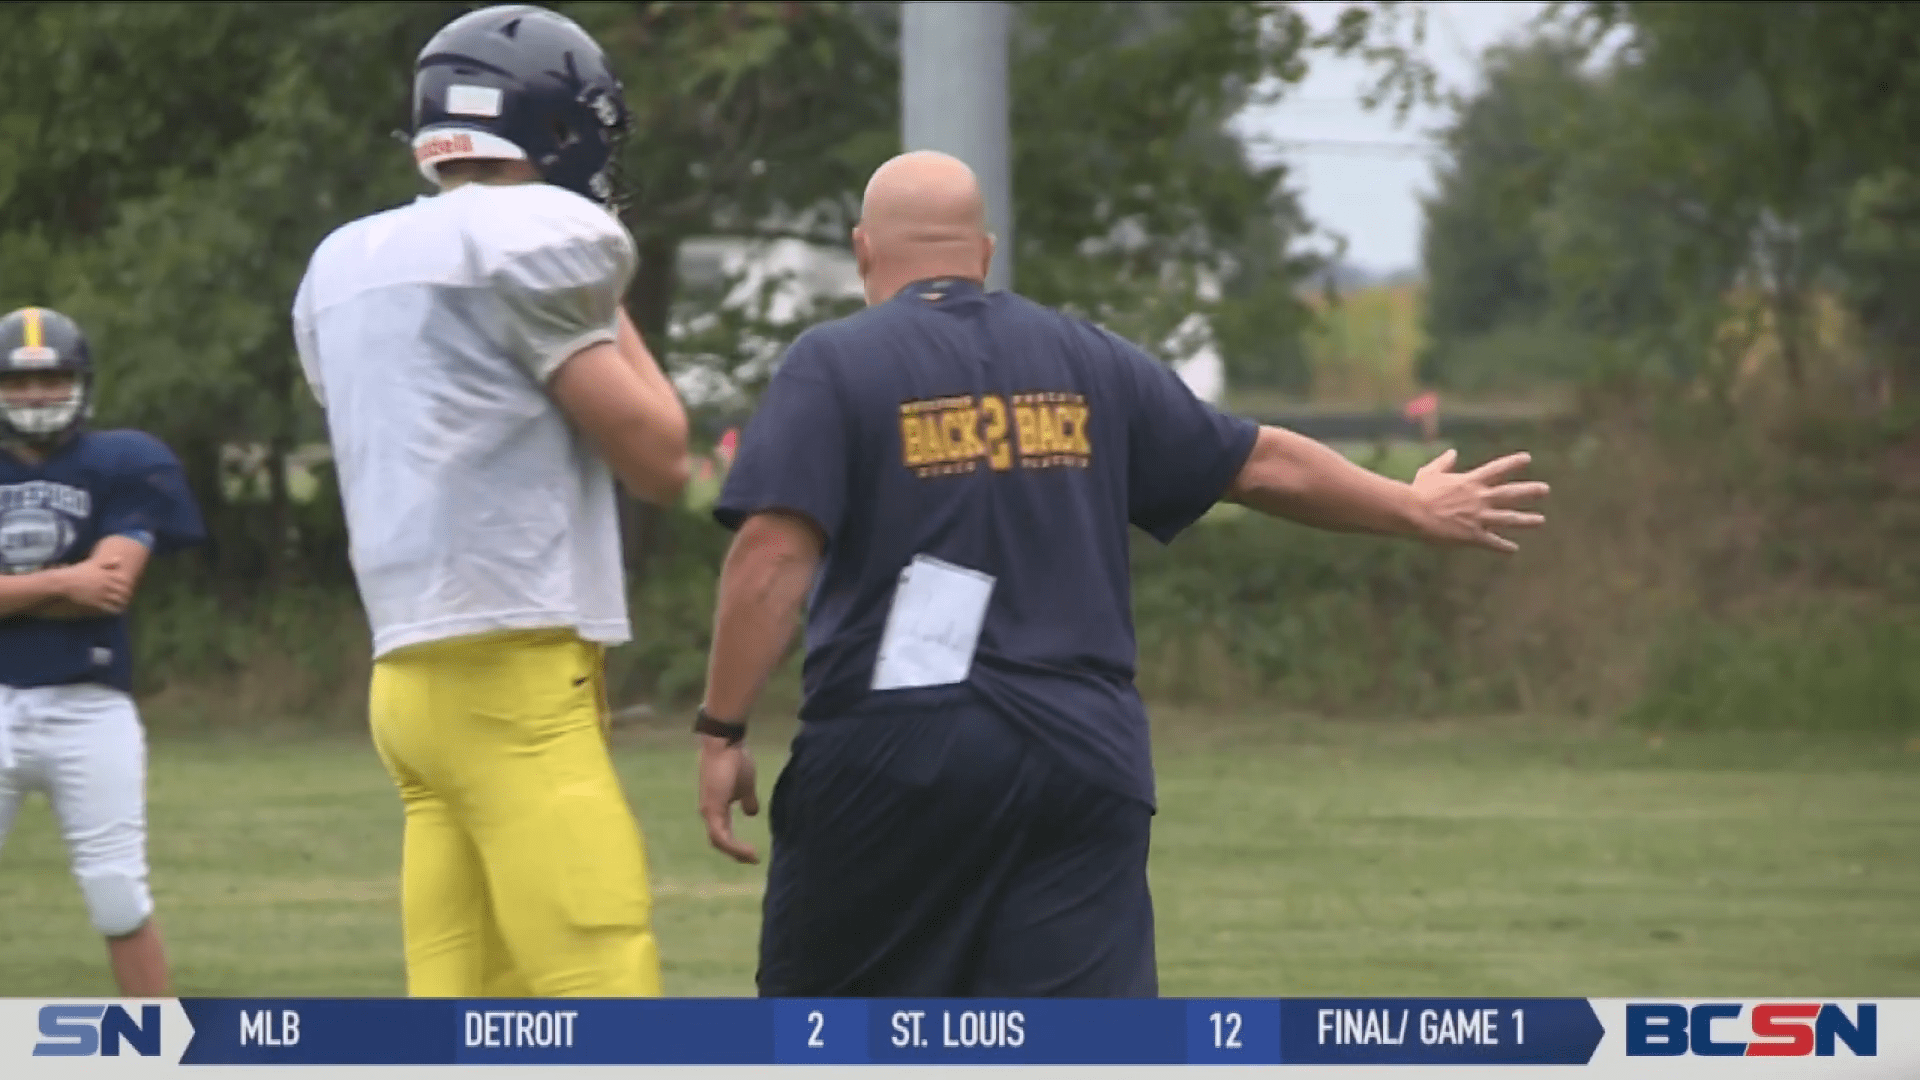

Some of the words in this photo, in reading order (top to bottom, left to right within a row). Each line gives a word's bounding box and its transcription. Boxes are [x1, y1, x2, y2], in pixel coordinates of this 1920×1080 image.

[902, 410, 989, 467] BACK
[981, 395, 1013, 470] 2
[1013, 404, 1092, 455] BACK
